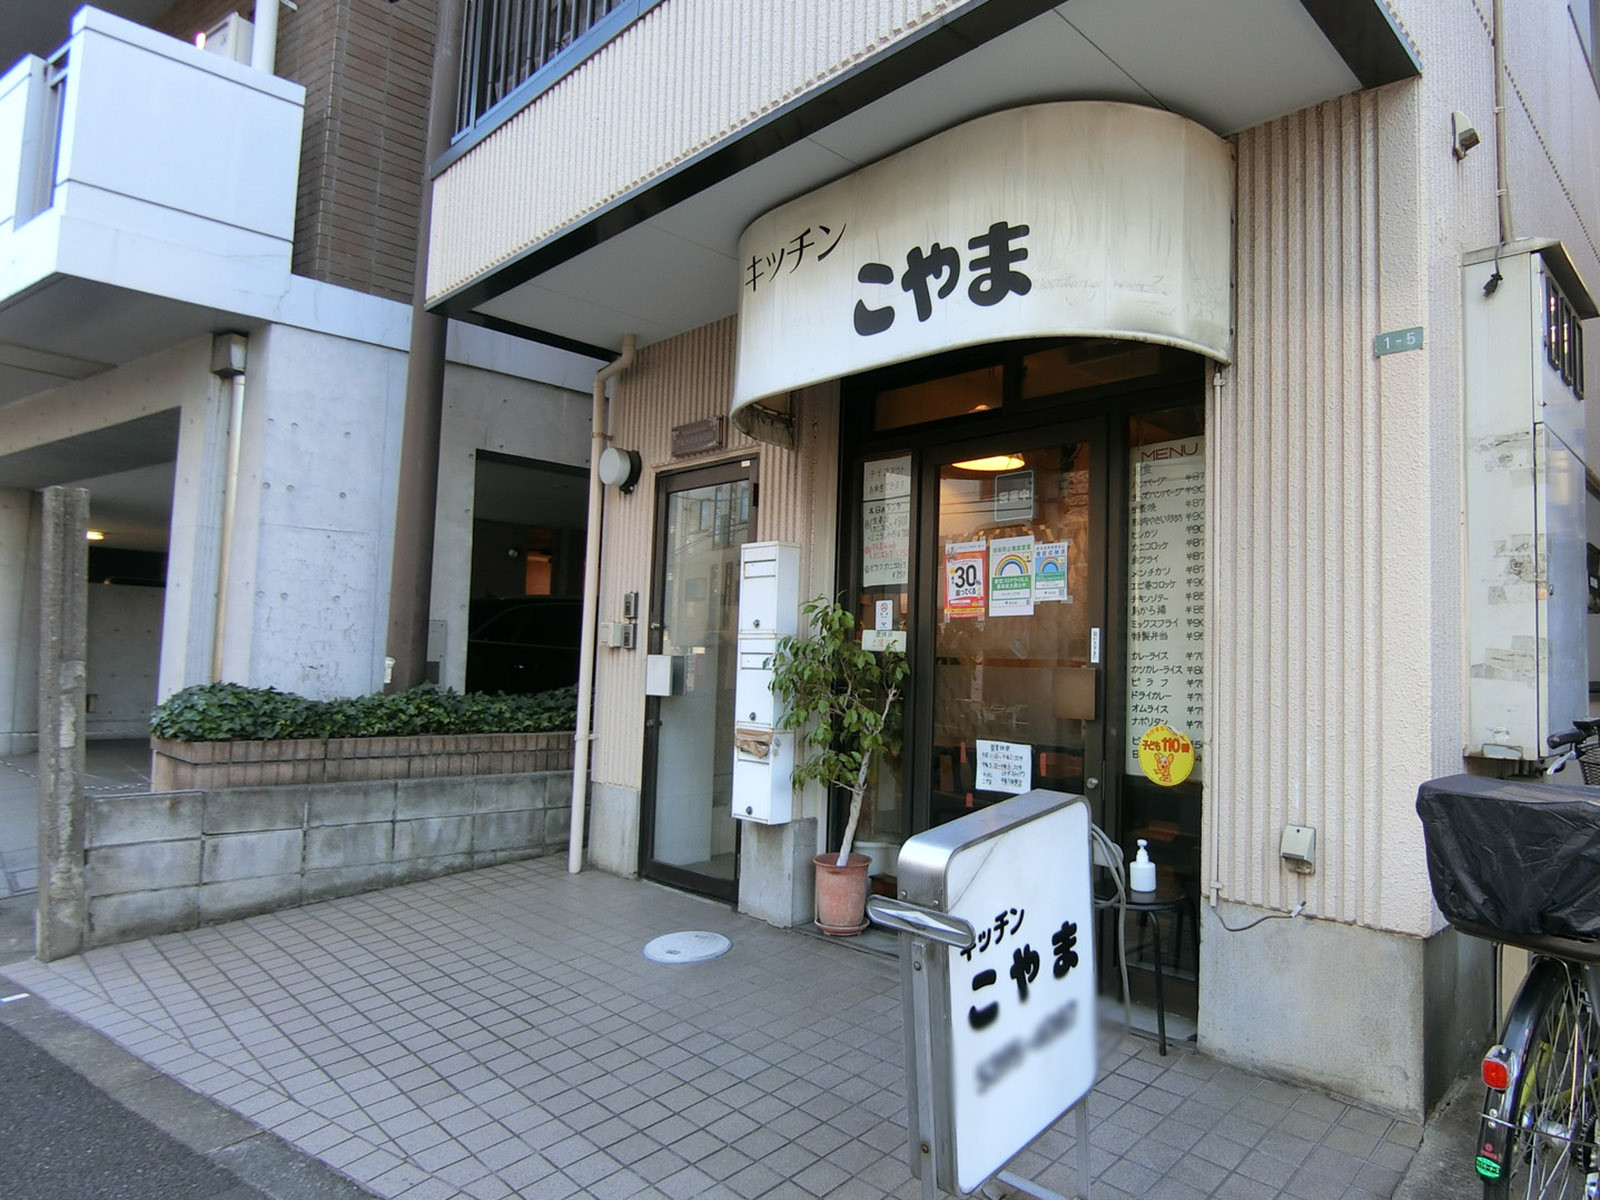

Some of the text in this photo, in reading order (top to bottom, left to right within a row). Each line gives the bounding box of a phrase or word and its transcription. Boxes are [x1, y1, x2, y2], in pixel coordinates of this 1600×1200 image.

[745, 221, 1032, 336] キッチン こやま
[1383, 332, 1416, 349] 1-5
[1141, 442, 1199, 462] MENU
[1131, 488, 1184, 502] チズハンバーグ
[1131, 567, 1171, 577] メンチカツ
[1131, 617, 1179, 629] ミックスフライ
[1131, 651, 1169, 661] カレーライス
[1131, 664, 1183, 675] カツカレーライス
[1131, 690, 1172, 701] ドライカレー
[1131, 703, 1203, 715] オムライス ¥7
[1131, 716, 1169, 727] ナポリタン
[968, 920, 1079, 1031] こやま
